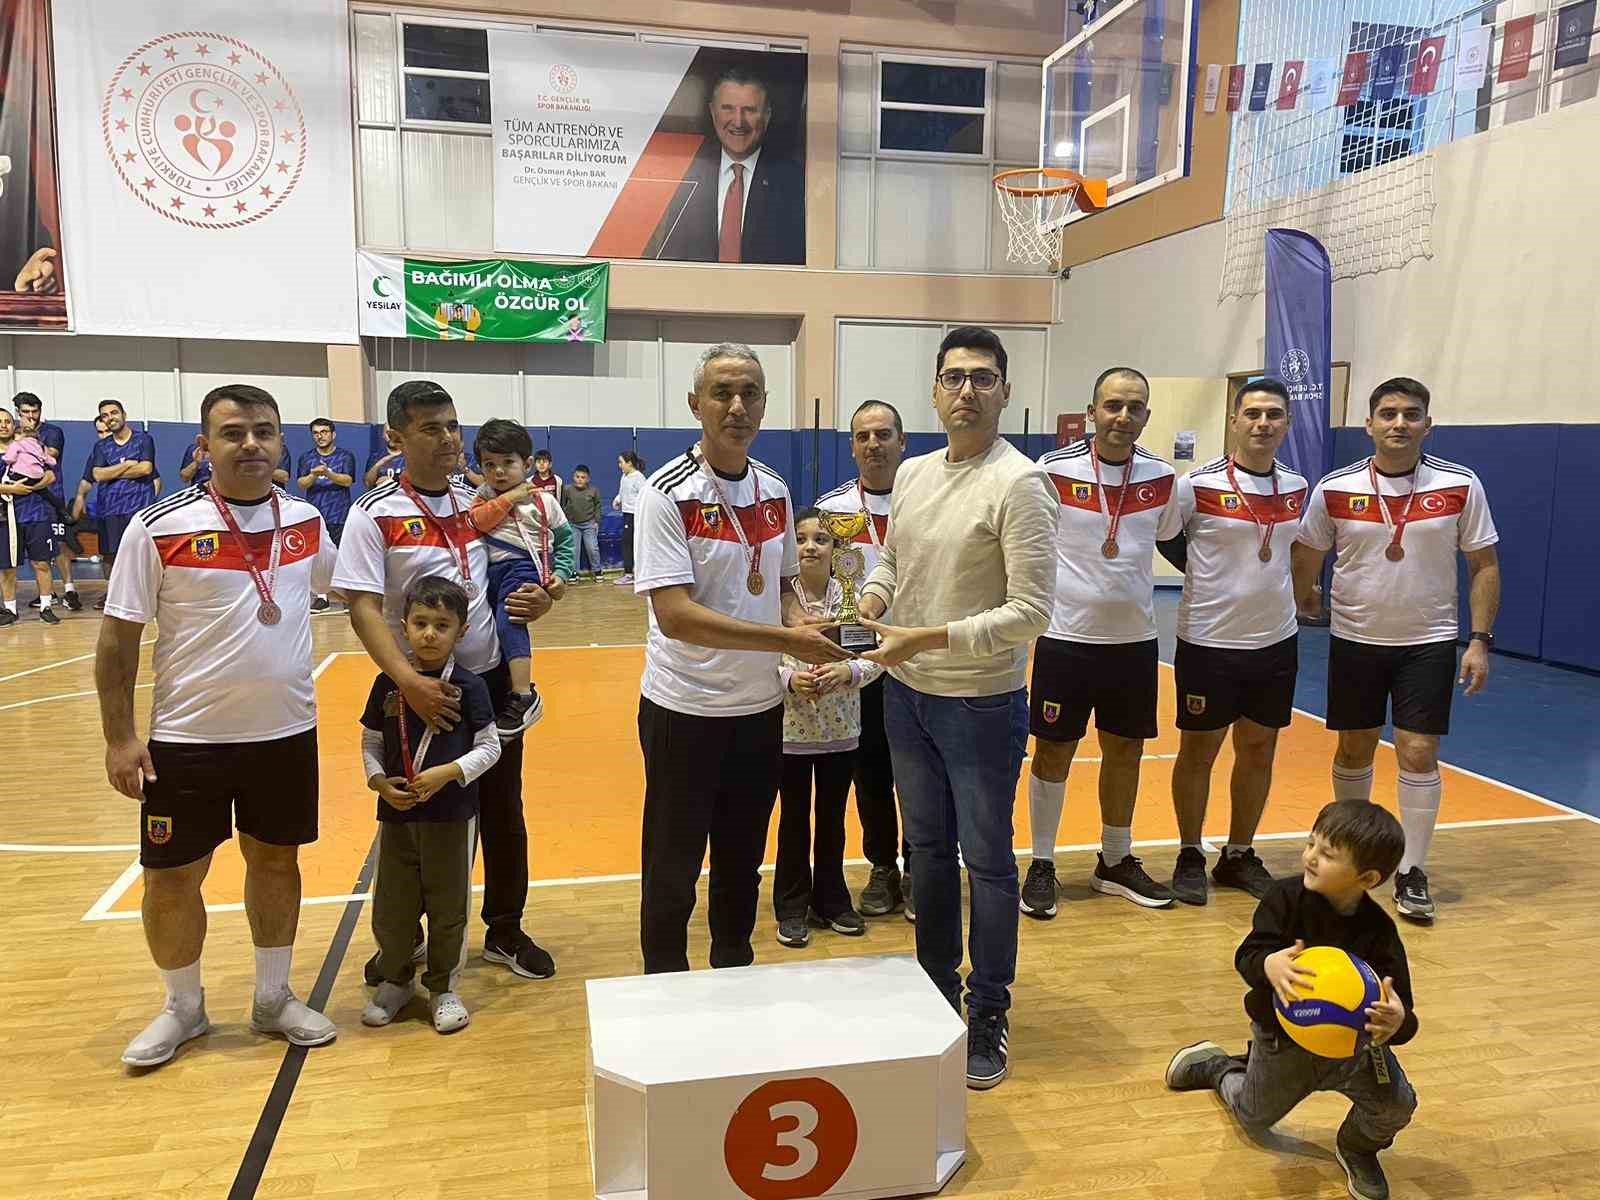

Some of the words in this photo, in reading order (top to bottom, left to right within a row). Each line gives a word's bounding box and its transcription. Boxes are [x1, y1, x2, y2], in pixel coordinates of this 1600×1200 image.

[184, 67, 240, 89] GENÇLİK
[240, 86, 257, 103] VE
[140, 68, 183, 145] CUMHURİYETİ
[255, 103, 270, 137] SPOR
[503, 117, 534, 133] TÜM
[537, 122, 606, 137] ANTRENÖR
[608, 126, 624, 139] VE
[508, 133, 620, 152] SPORCULARIMIZA
[224, 139, 270, 192] BAKANLIĞI
[502, 148, 564, 162] BAŞARILAR
[566, 151, 627, 165] DİLİYORUM
[147, 147, 192, 190] TÜRKİYE
[524, 166, 536, 175] Dr.
[537, 166, 565, 176] Osman
[566, 168, 588, 178] Aşkın
[589, 170, 606, 178] BAK
[513, 175, 549, 187] GENÇLİK
[549, 177, 561, 186] VE
[562, 178, 585, 188] SPOR
[586, 180, 618, 190] BAKANI
[412, 269, 492, 288] BAĞIMLI
[497, 274, 552, 291] OLMA
[494, 291, 560, 311] ÖZGÜR
[564, 296, 590, 311] OL
[760, 1100, 820, 1182] 3
